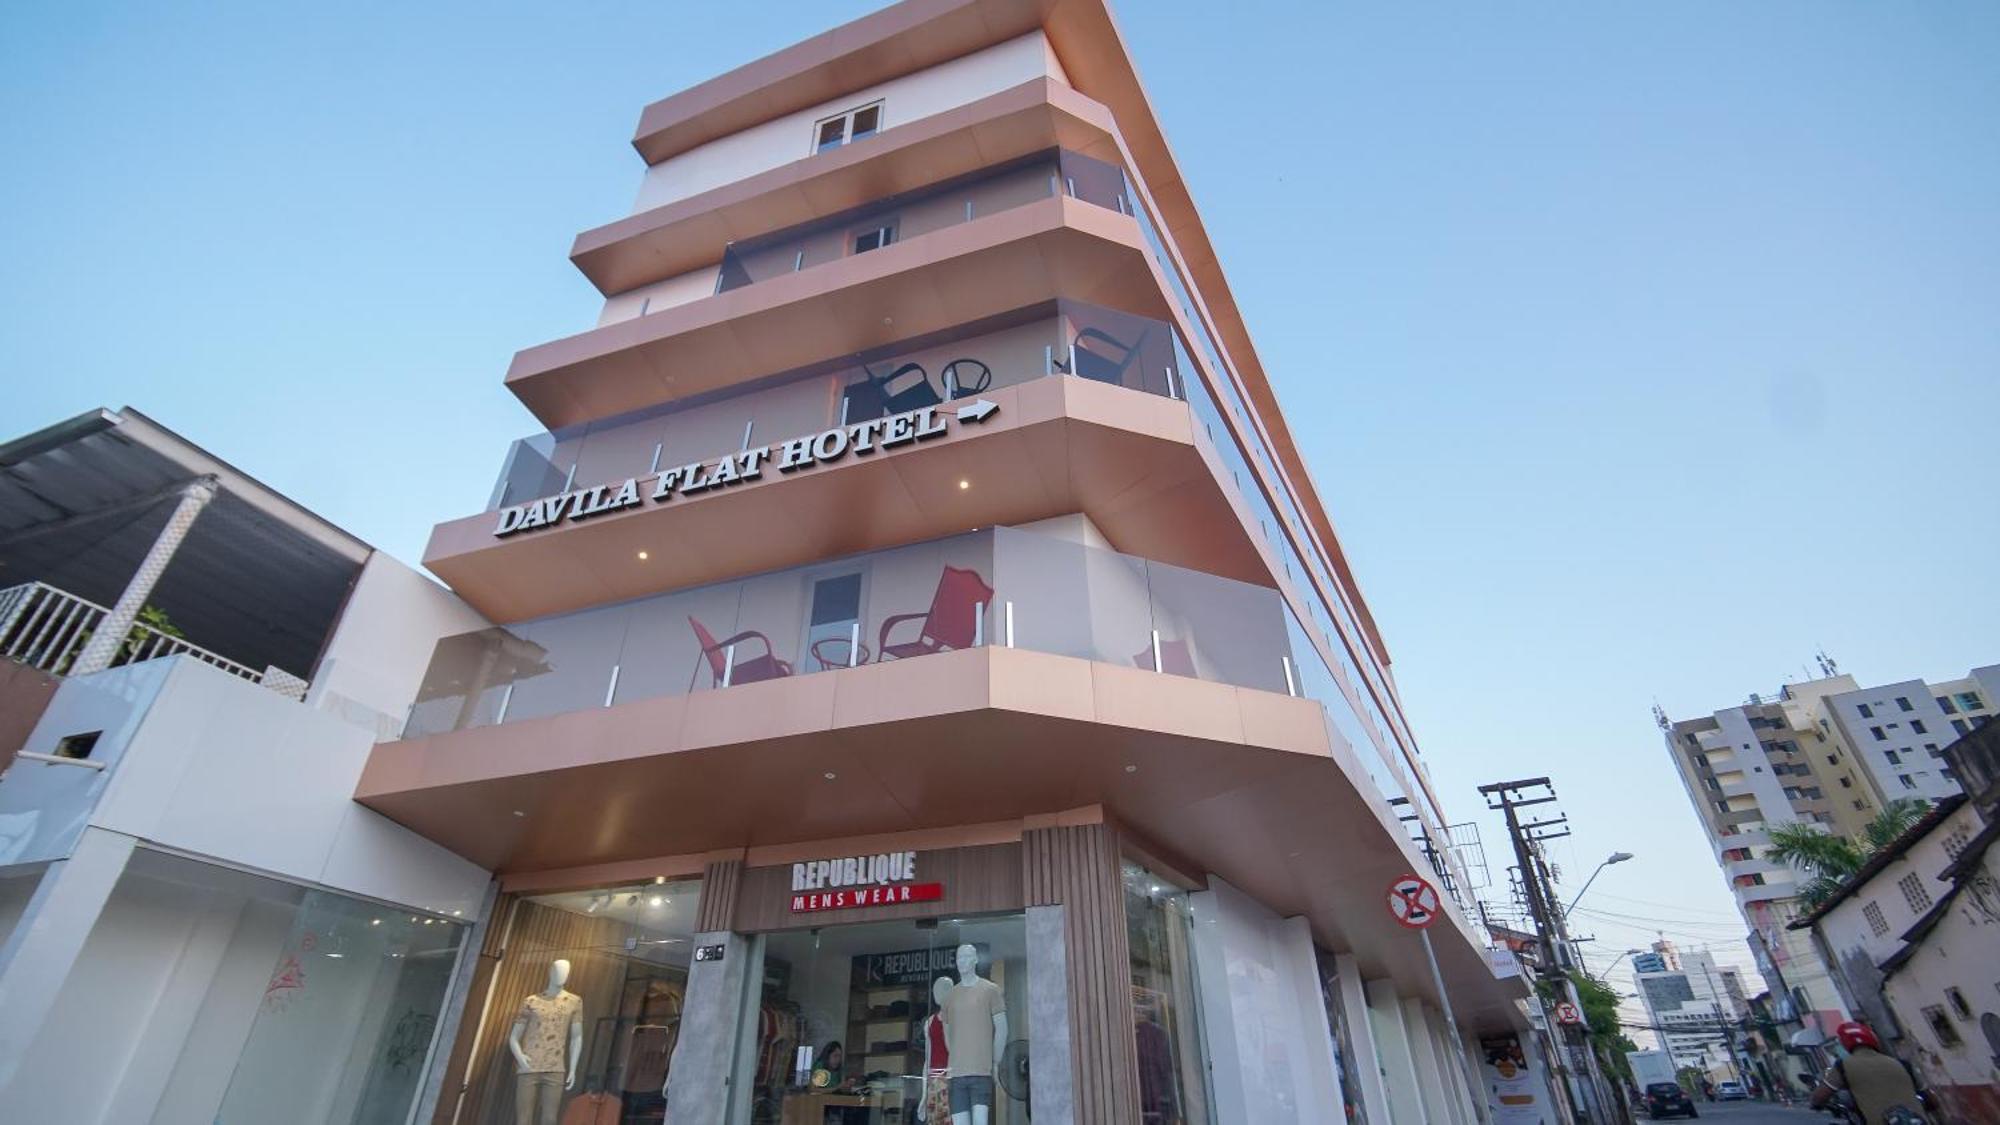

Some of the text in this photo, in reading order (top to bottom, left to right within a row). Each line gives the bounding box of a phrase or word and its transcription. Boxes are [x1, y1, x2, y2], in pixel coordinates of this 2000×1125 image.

[493, 405, 948, 537] DAVILA FLAT HOTEL
[791, 851, 917, 892] REPUBLIQUE
[792, 886, 911, 911] MENS WEAR
[884, 949, 956, 976] REPUBLQUE
